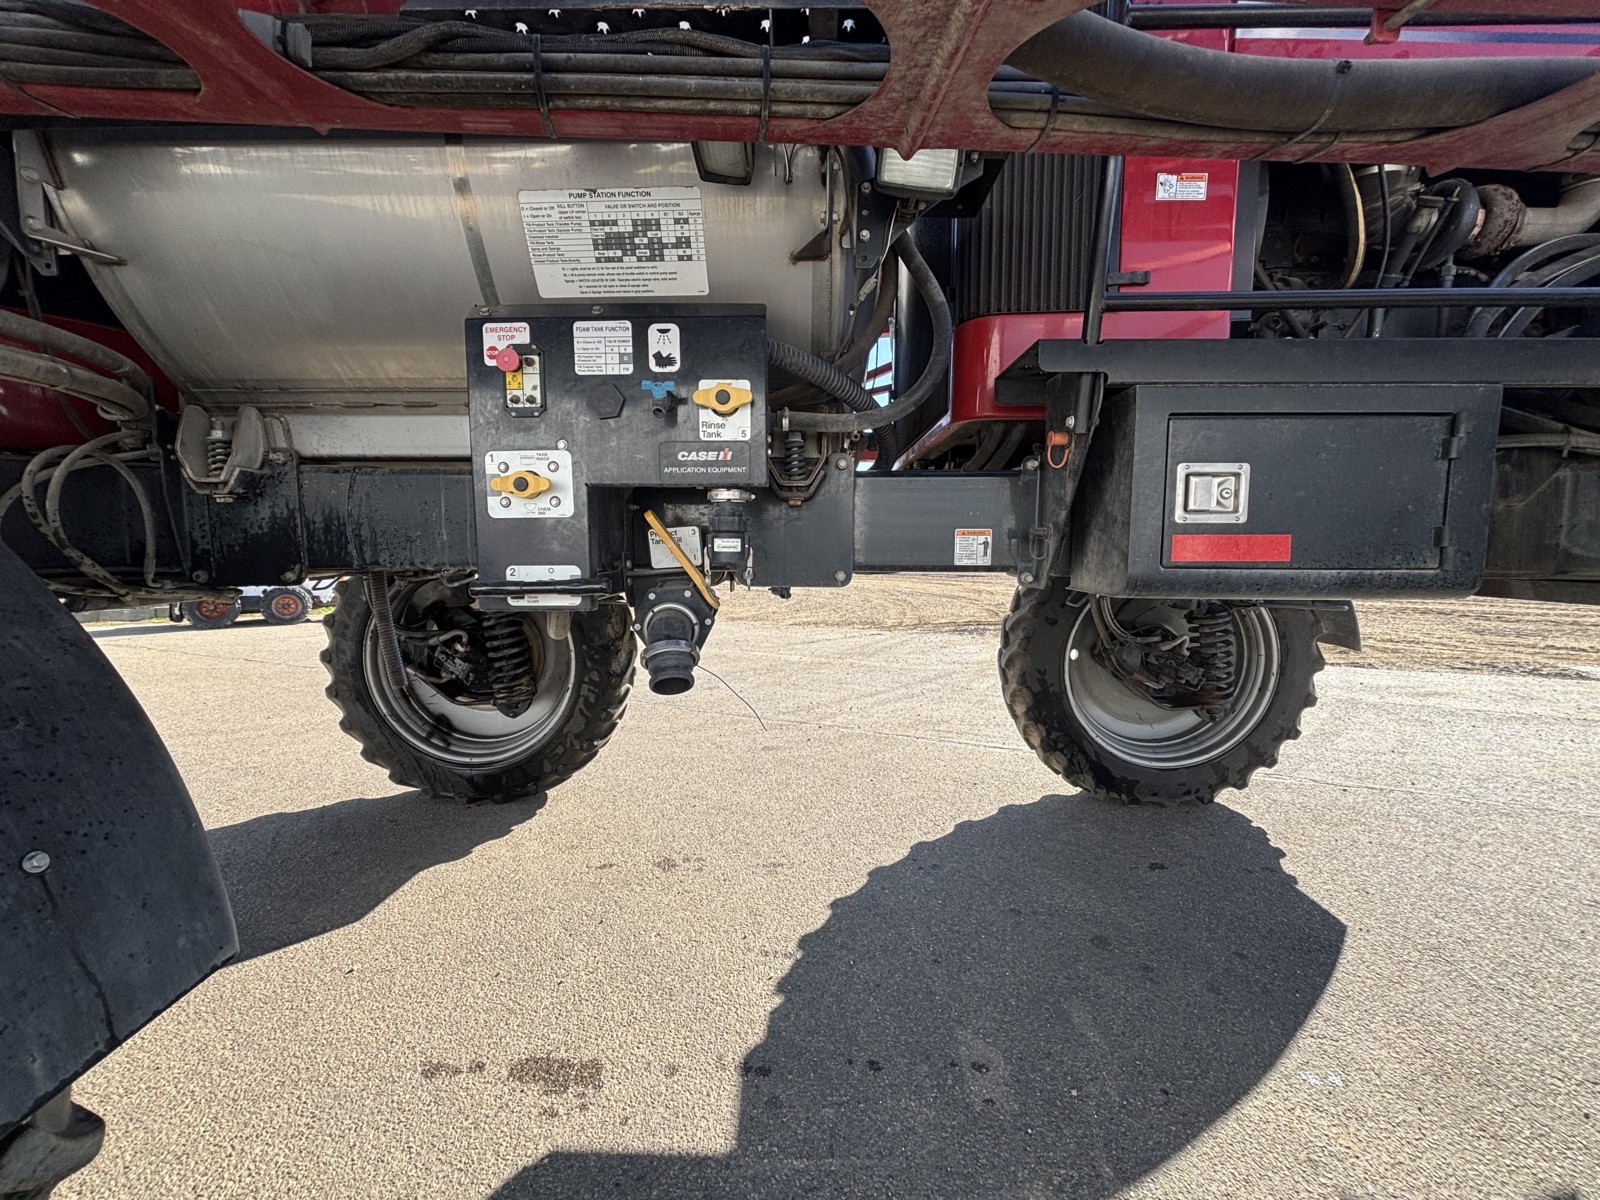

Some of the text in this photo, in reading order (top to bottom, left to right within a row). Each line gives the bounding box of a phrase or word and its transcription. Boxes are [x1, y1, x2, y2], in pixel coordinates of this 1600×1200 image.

[701, 421, 726, 429] Rinse
[489, 454, 494, 462] 1
[678, 451, 718, 460] CASE
[510, 568, 516, 576] 2
